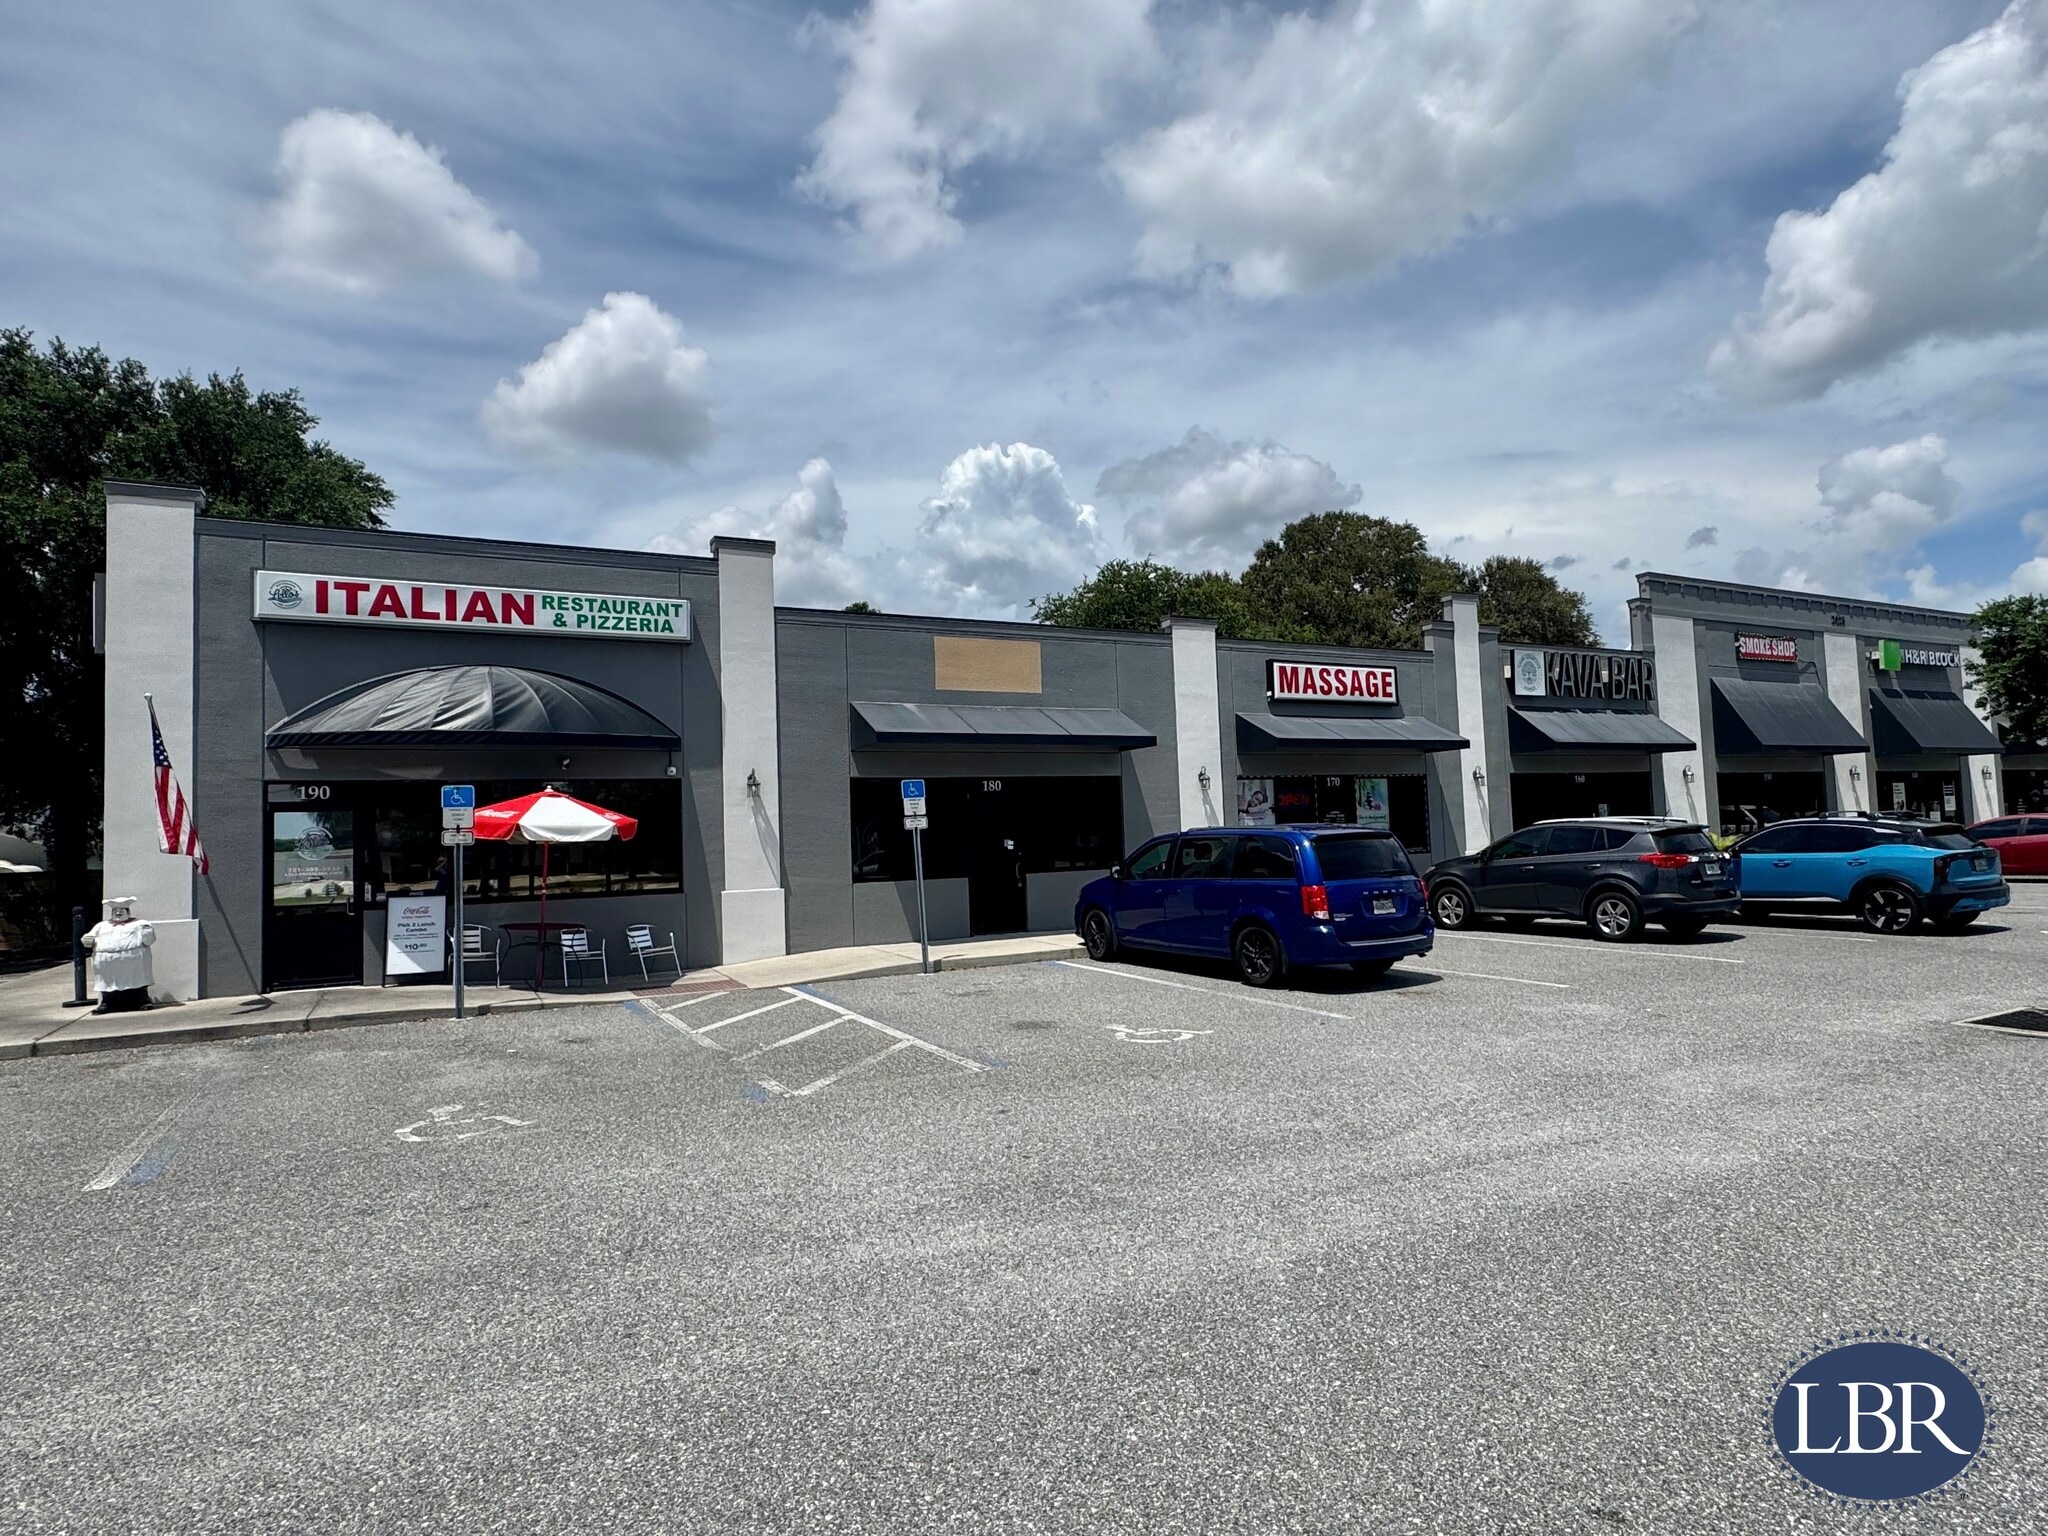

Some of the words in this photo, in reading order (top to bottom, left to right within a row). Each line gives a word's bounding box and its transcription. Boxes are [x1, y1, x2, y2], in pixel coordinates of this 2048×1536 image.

[315, 580, 535, 626] ITALIAN
[541, 595, 683, 618] RESTAURANT
[552, 612, 568, 628] &
[576, 613, 674, 633] PIZZERIA
[1739, 636, 1771, 655] SMOKE
[1772, 639, 1796, 657] SHOP
[1905, 648, 1927, 665] H&R
[1928, 651, 1960, 668] BLOCK
[1278, 665, 1393, 698] MASSAGE
[1545, 651, 1605, 698] KAVA
[1610, 656, 1655, 700] BAR
[297, 785, 331, 800] 190
[982, 780, 1002, 792] 180
[1326, 777, 1341, 787] 170
